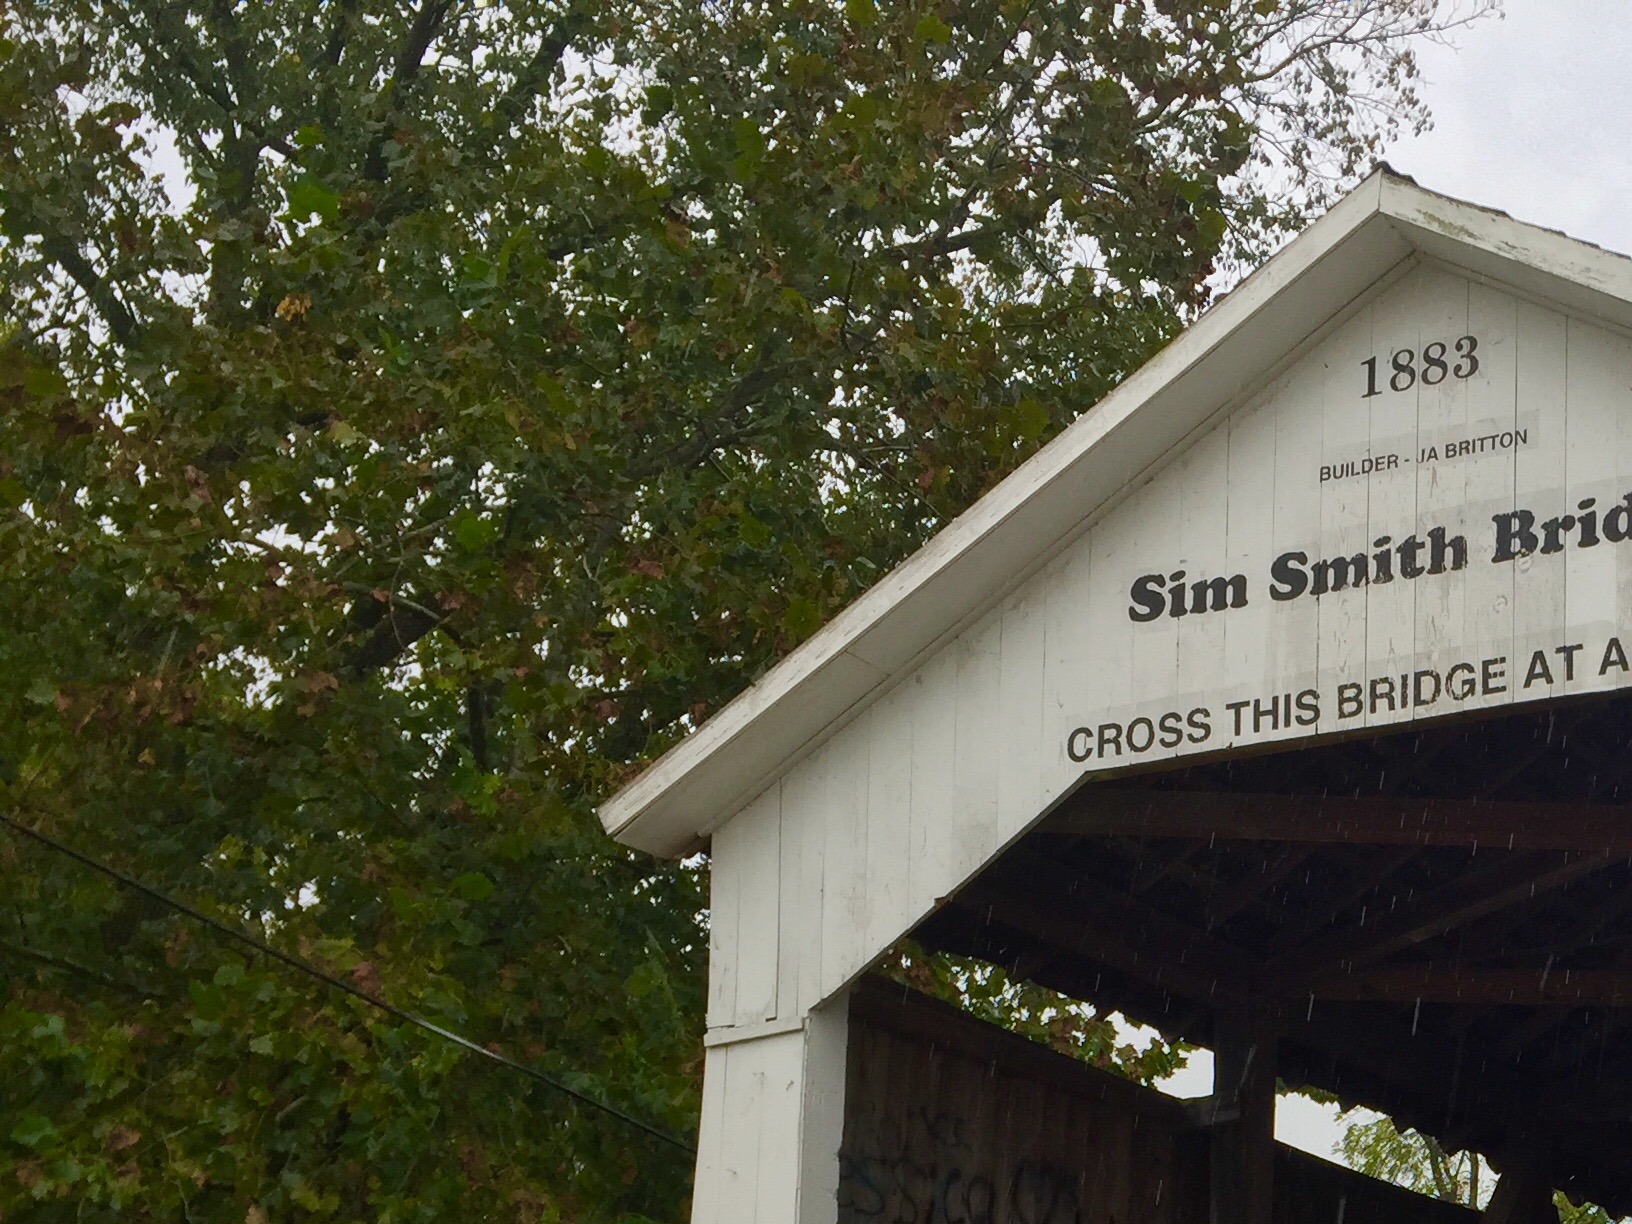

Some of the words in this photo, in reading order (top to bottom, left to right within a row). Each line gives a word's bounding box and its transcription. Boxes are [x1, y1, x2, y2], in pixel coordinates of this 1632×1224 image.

[1360, 335, 1480, 398] 1883
[1319, 453, 1399, 483] BUILDER
[1415, 446, 1439, 464] JA
[1445, 429, 1528, 459] BRITTON
[1129, 572, 1249, 623] Sim
[1269, 526, 1469, 602] Smith
[1066, 707, 1212, 763] CROSS
[1225, 688, 1321, 737] THIS
[1337, 655, 1508, 721] BRIDGE
[1523, 643, 1584, 689] AT
[1598, 637, 1631, 676] A
